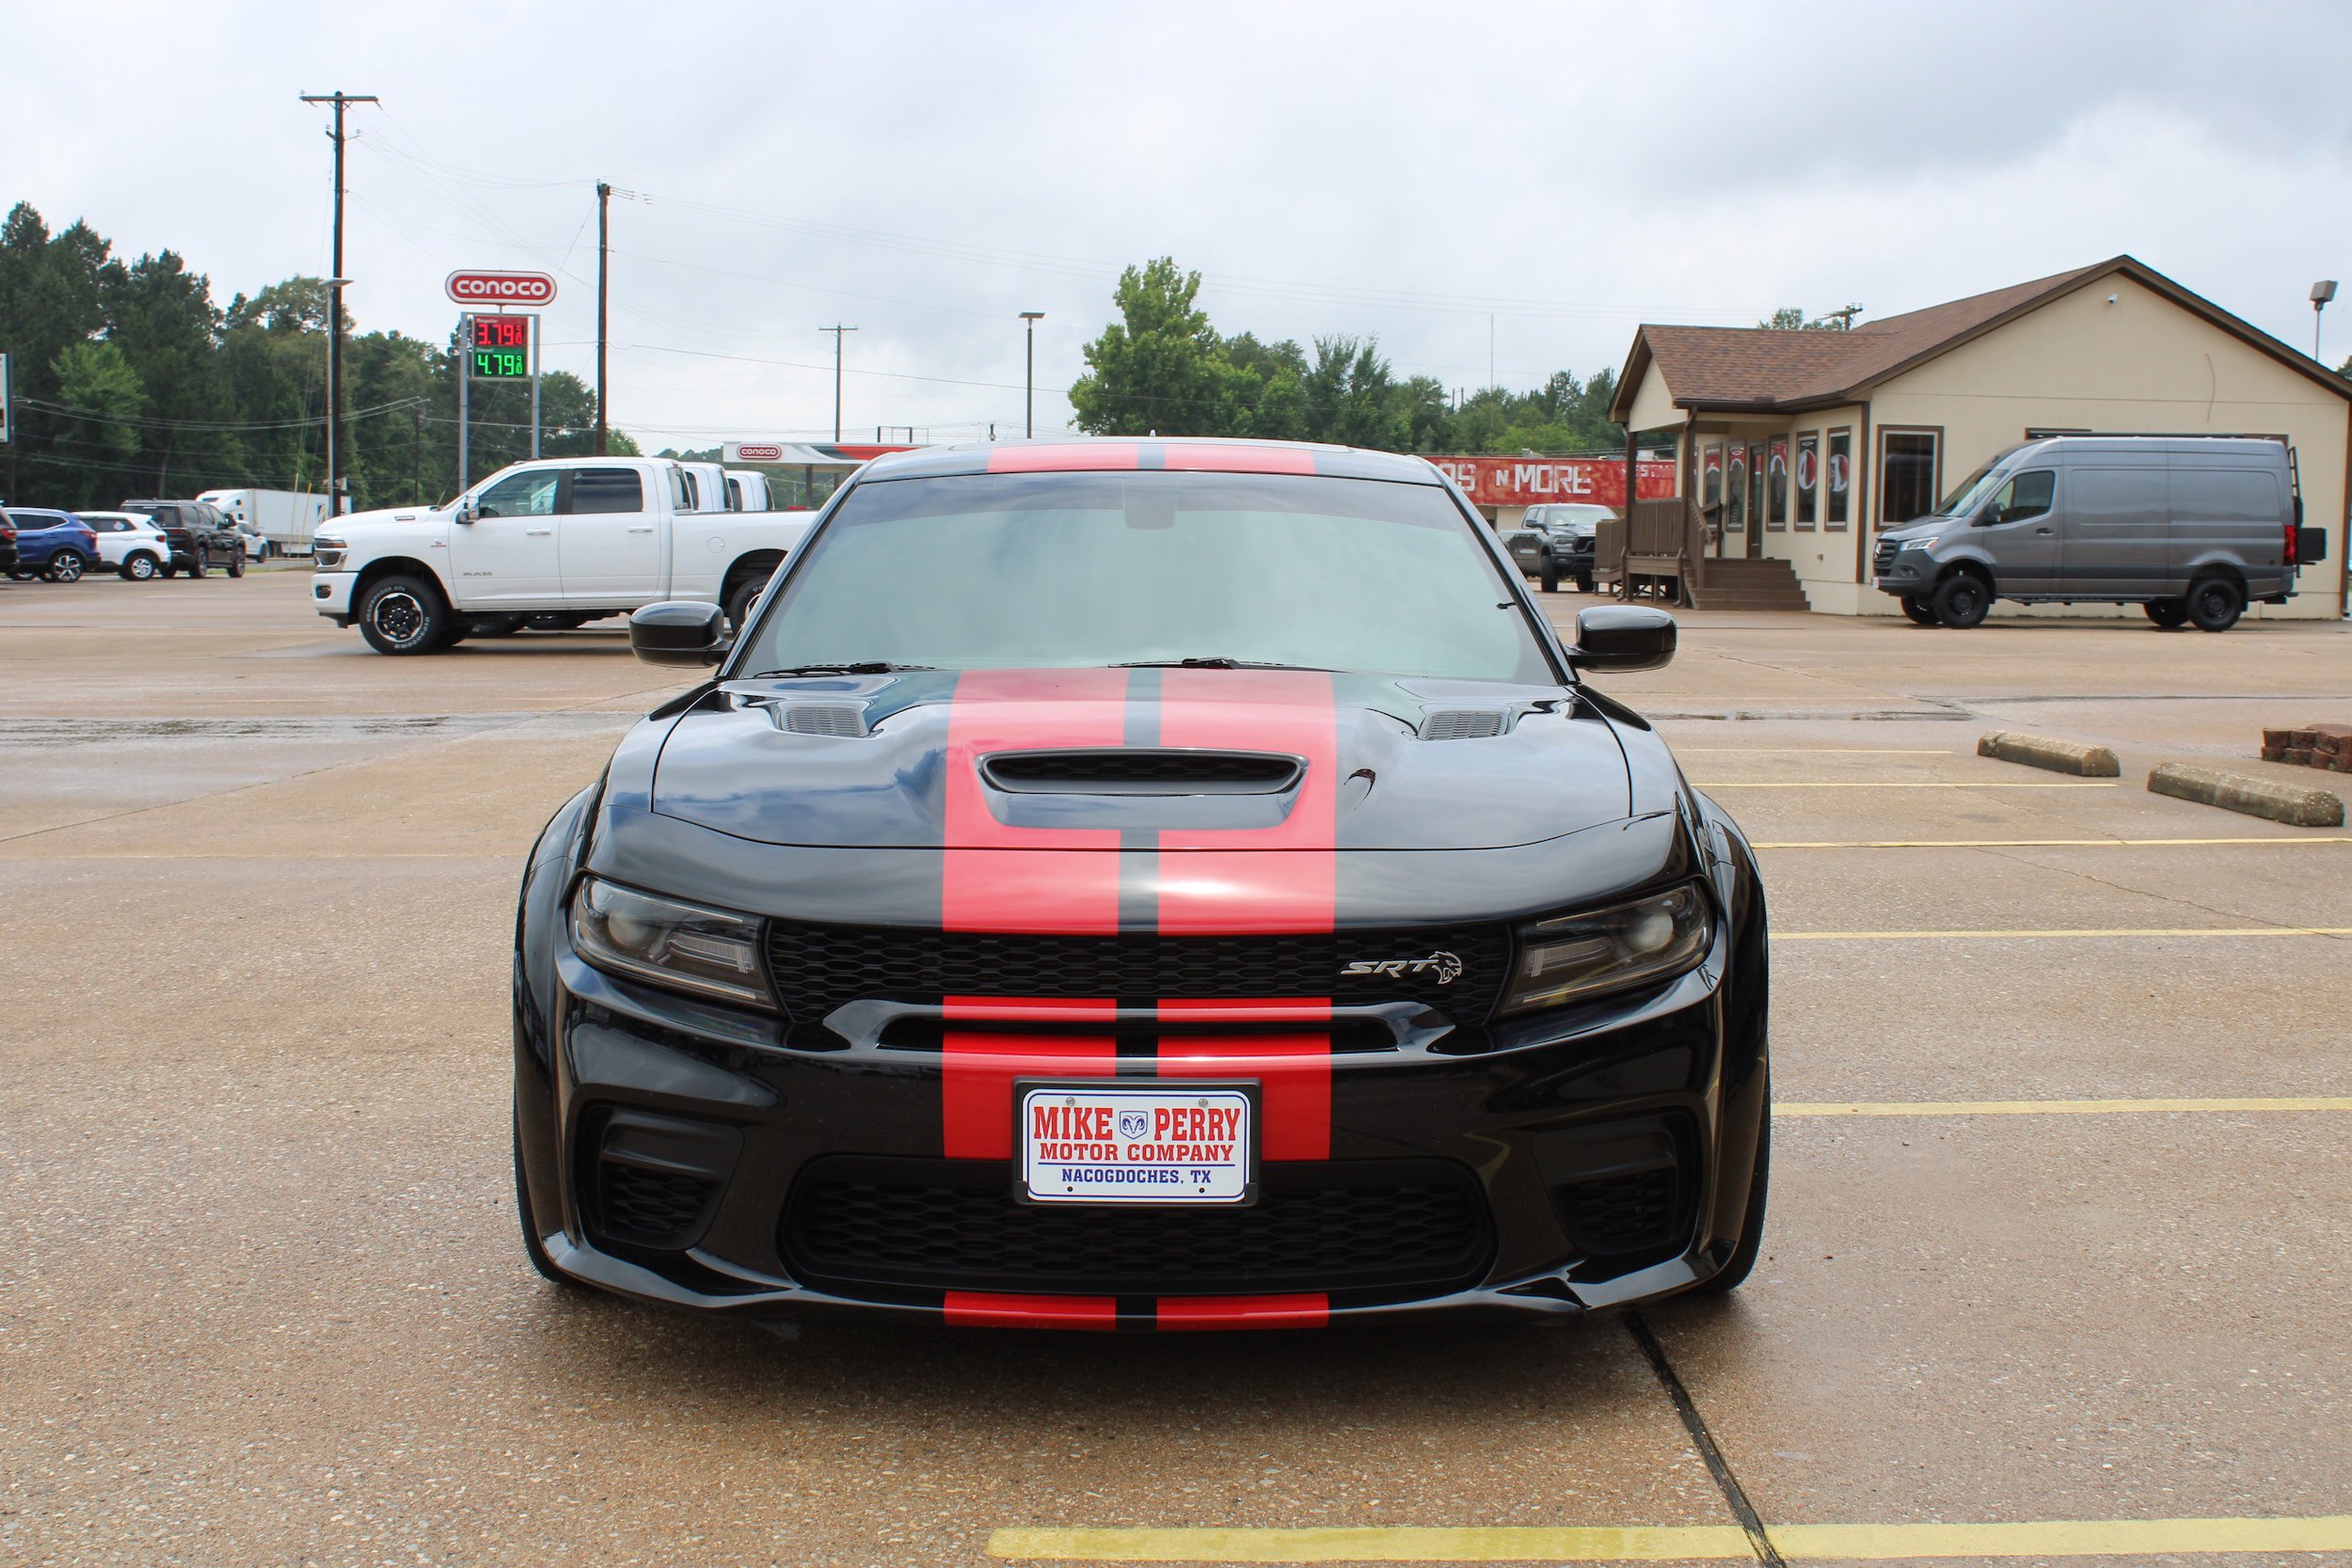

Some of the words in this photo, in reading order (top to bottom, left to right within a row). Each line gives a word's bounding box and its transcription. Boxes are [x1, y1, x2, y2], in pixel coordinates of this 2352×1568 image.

[1515, 464, 1592, 495] MORE
[1341, 959, 1439, 978] SRT
[1034, 1106, 1113, 1140] MIKE
[1154, 1108, 1241, 1141] PERRY
[1040, 1143, 1119, 1161] MOTOR
[1128, 1144, 1234, 1162] COMPANY
[1062, 1168, 1184, 1184] NACOGDOCHES,
[1191, 1169, 1212, 1183] TX
